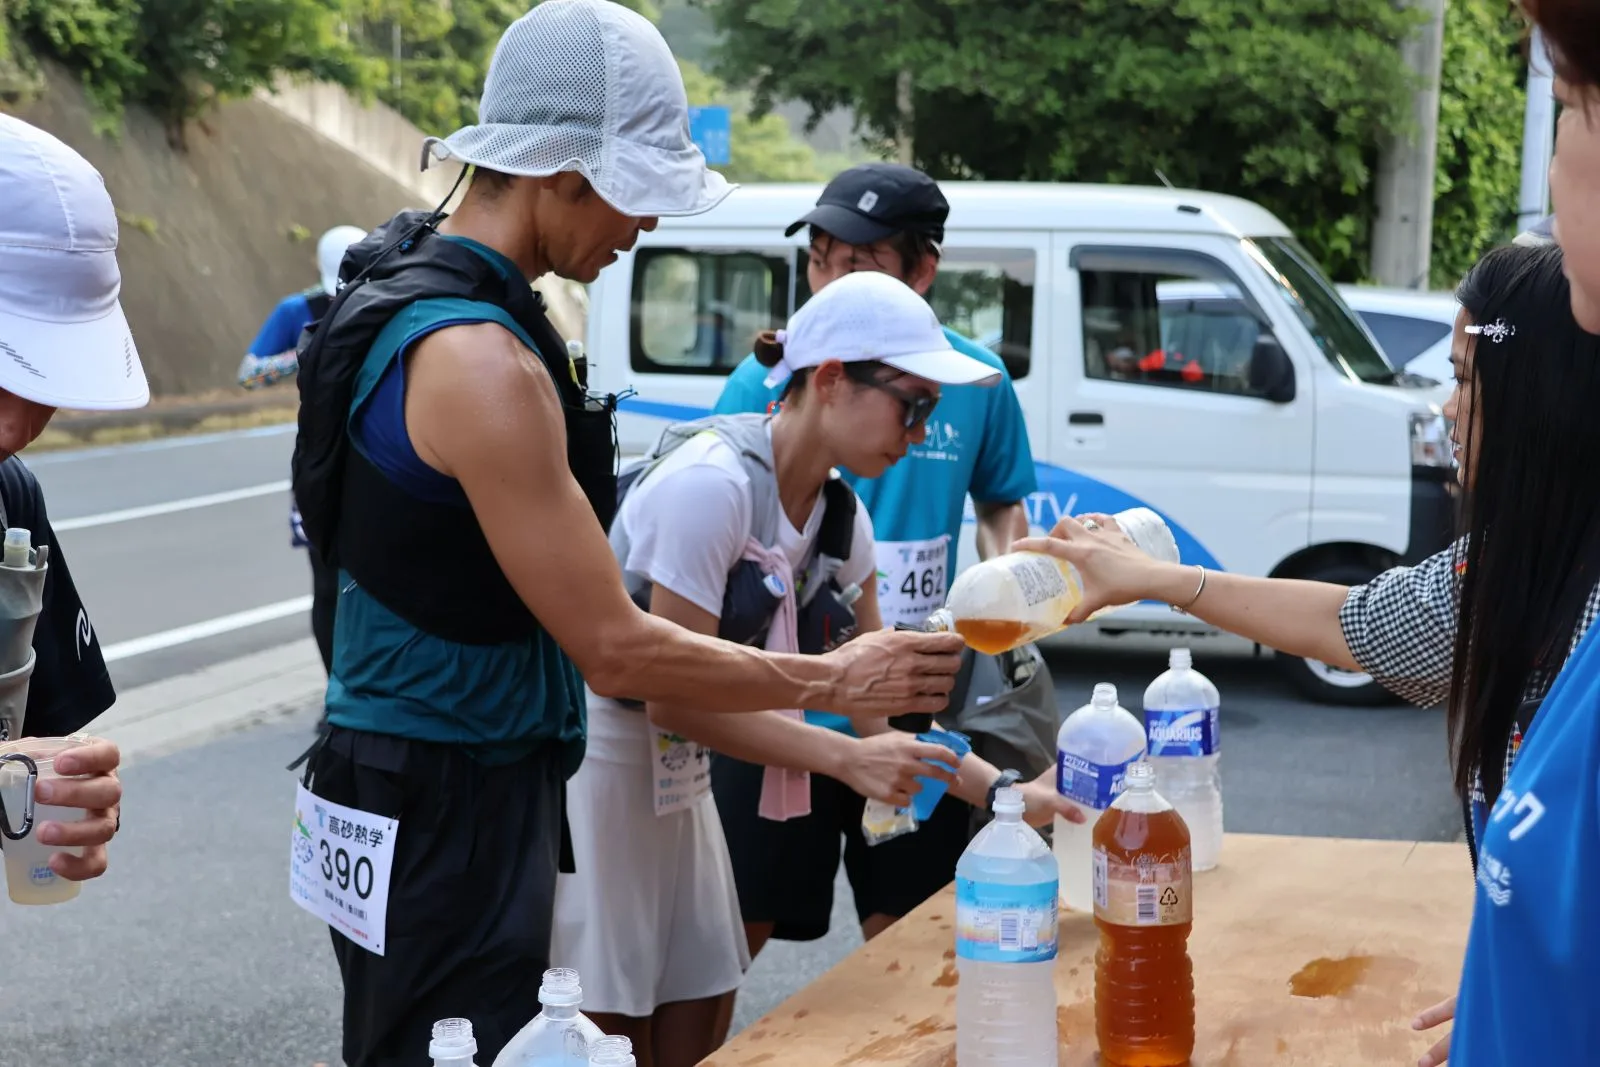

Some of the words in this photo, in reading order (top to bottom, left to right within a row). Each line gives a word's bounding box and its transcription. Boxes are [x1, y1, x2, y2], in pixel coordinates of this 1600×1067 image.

[900, 565, 943, 601] 462
[1148, 726, 1203, 742] AQUARIUS
[328, 815, 384, 848] 高砂熱学
[319, 838, 374, 901] 390
